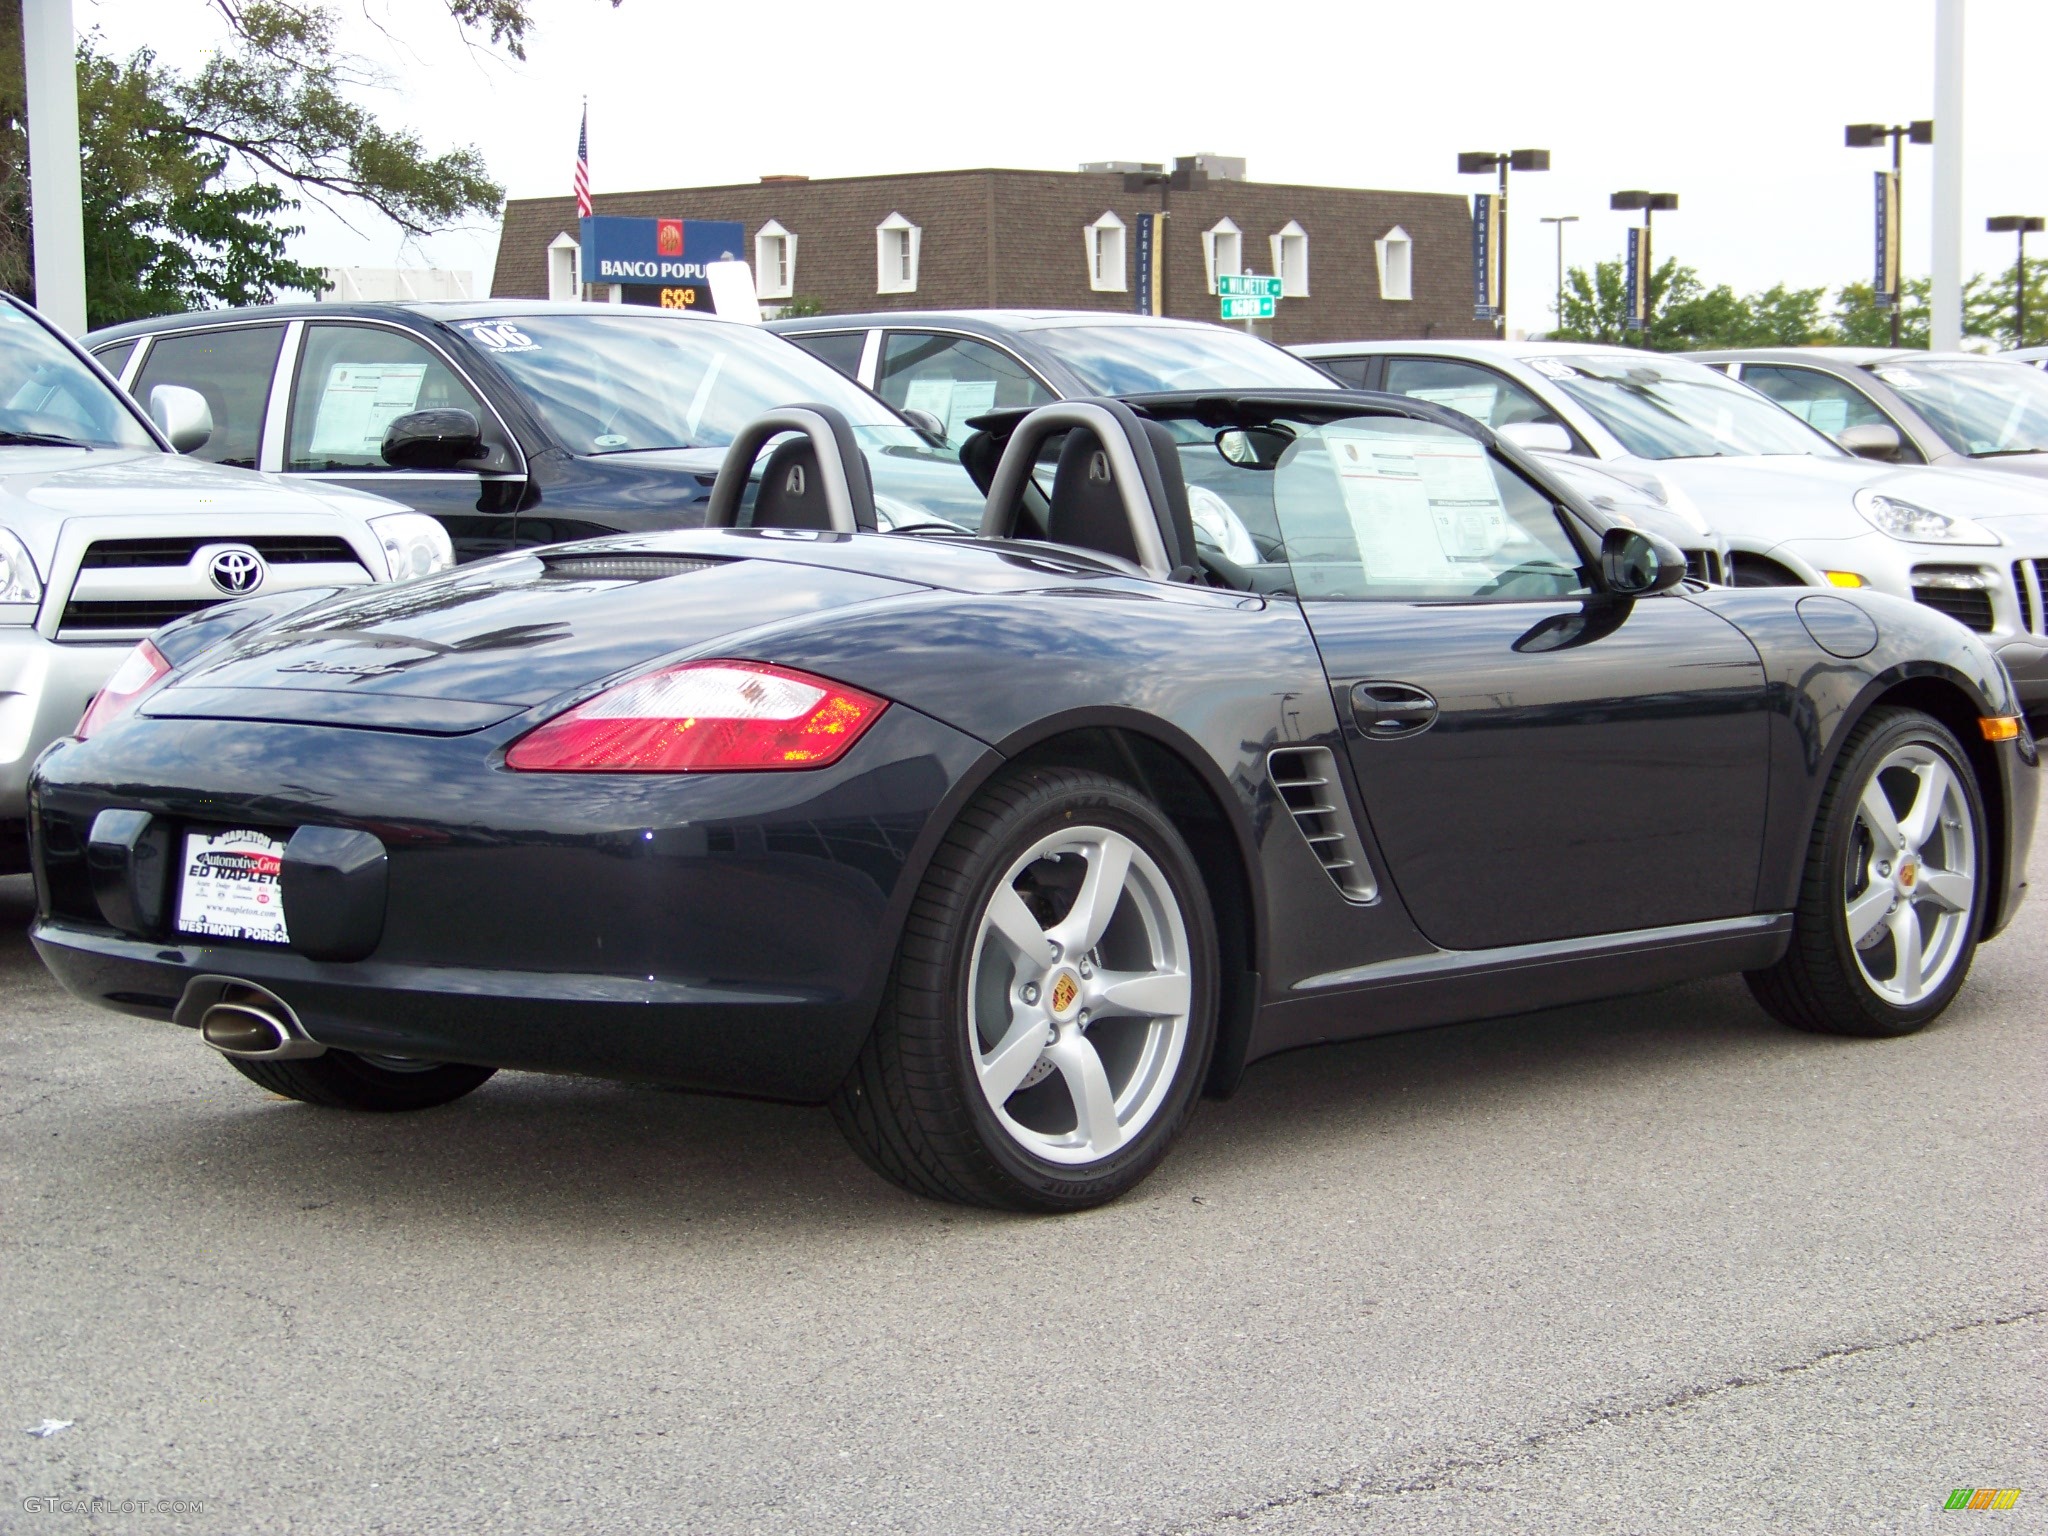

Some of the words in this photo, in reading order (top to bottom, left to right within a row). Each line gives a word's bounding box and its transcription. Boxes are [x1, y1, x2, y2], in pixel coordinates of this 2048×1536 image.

[601, 260, 658, 278] BANCO
[1229, 278, 1270, 295] WILMETTE
[473, 325, 532, 348] 06
[189, 865, 211, 877] ED
[214, 867, 280, 884] NAPLET
[207, 904, 276, 918] www.napleton.com
[179, 920, 241, 938] WESTMONT
